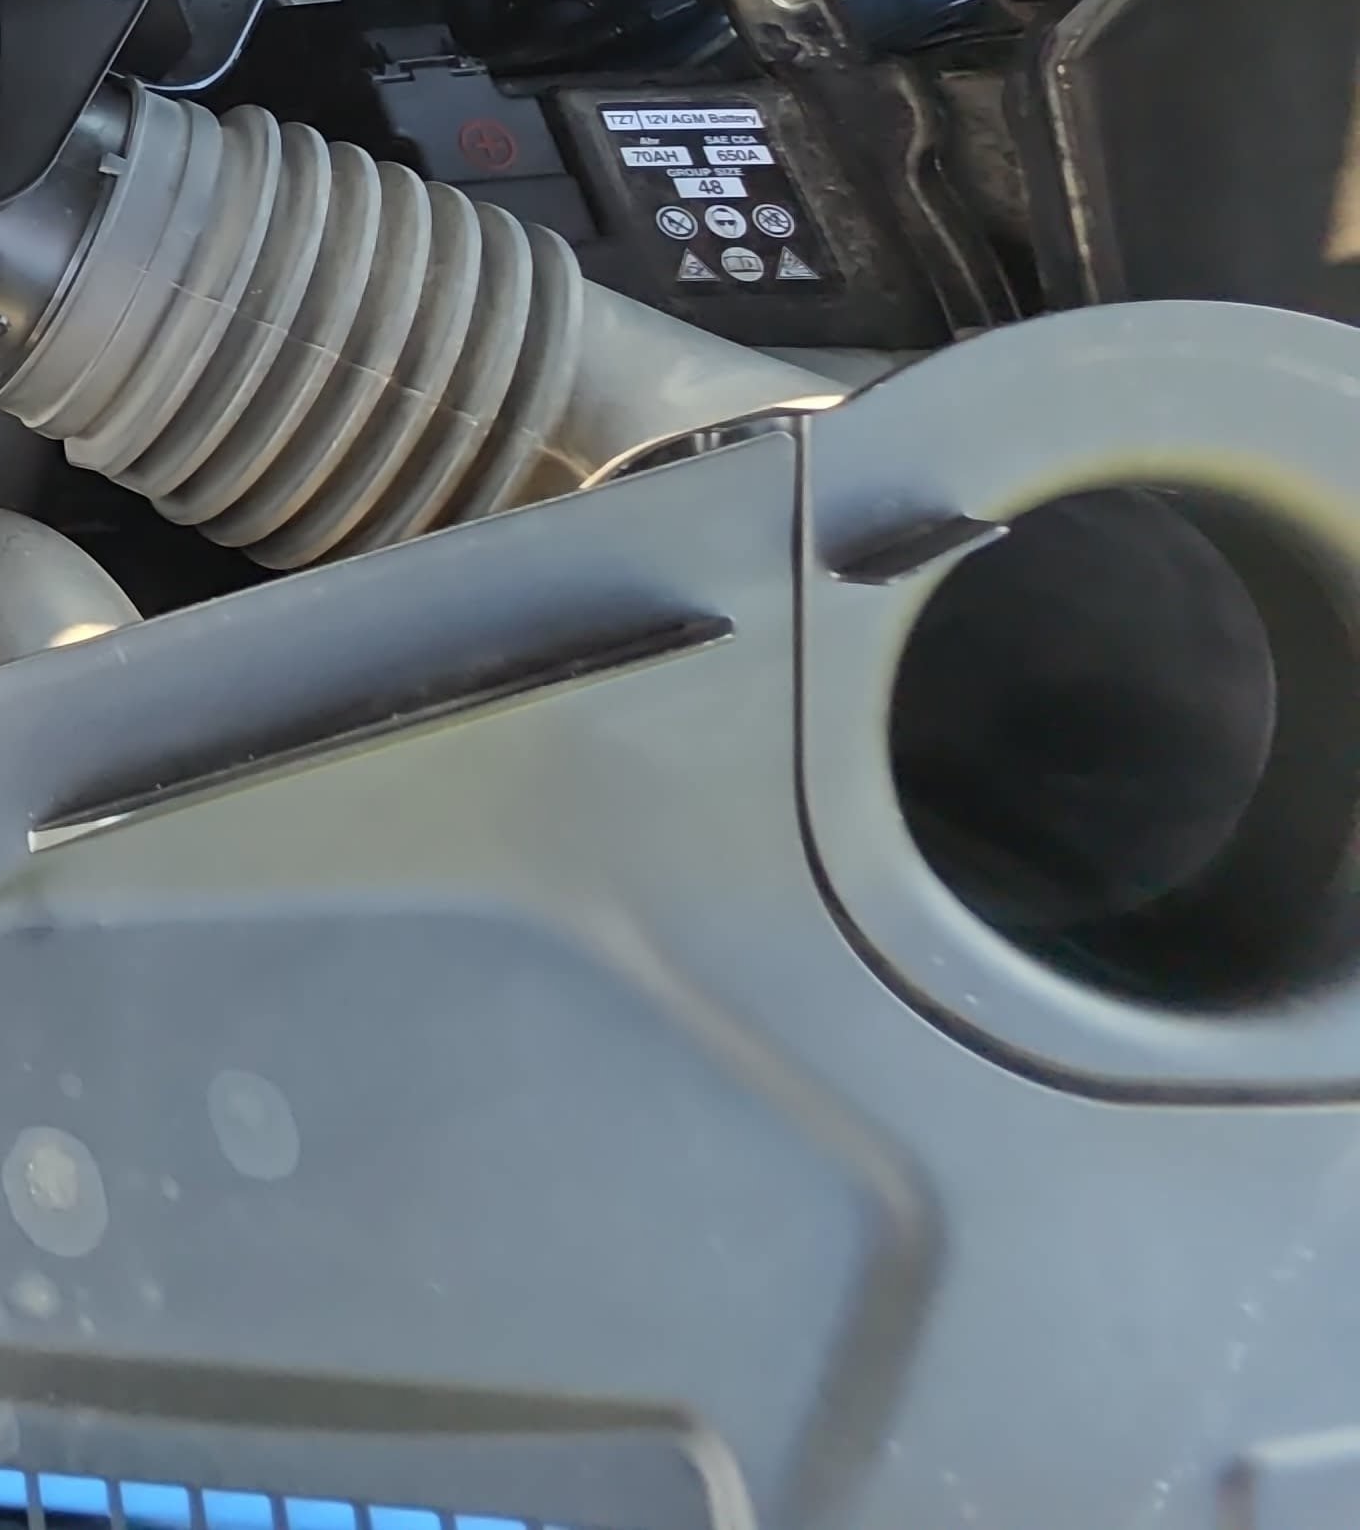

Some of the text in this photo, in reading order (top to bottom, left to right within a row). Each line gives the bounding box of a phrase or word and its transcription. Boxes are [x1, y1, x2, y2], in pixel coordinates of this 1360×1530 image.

[645, 114, 667, 125] 12V
[671, 113, 706, 124] AGM
[708, 113, 757, 126] Battery
[704, 135, 759, 144] SAE CCA
[631, 150, 680, 163] 70AH
[716, 149, 761, 162] 650A
[666, 167, 746, 177] GROUP SIZE
[698, 179, 725, 195] 48
